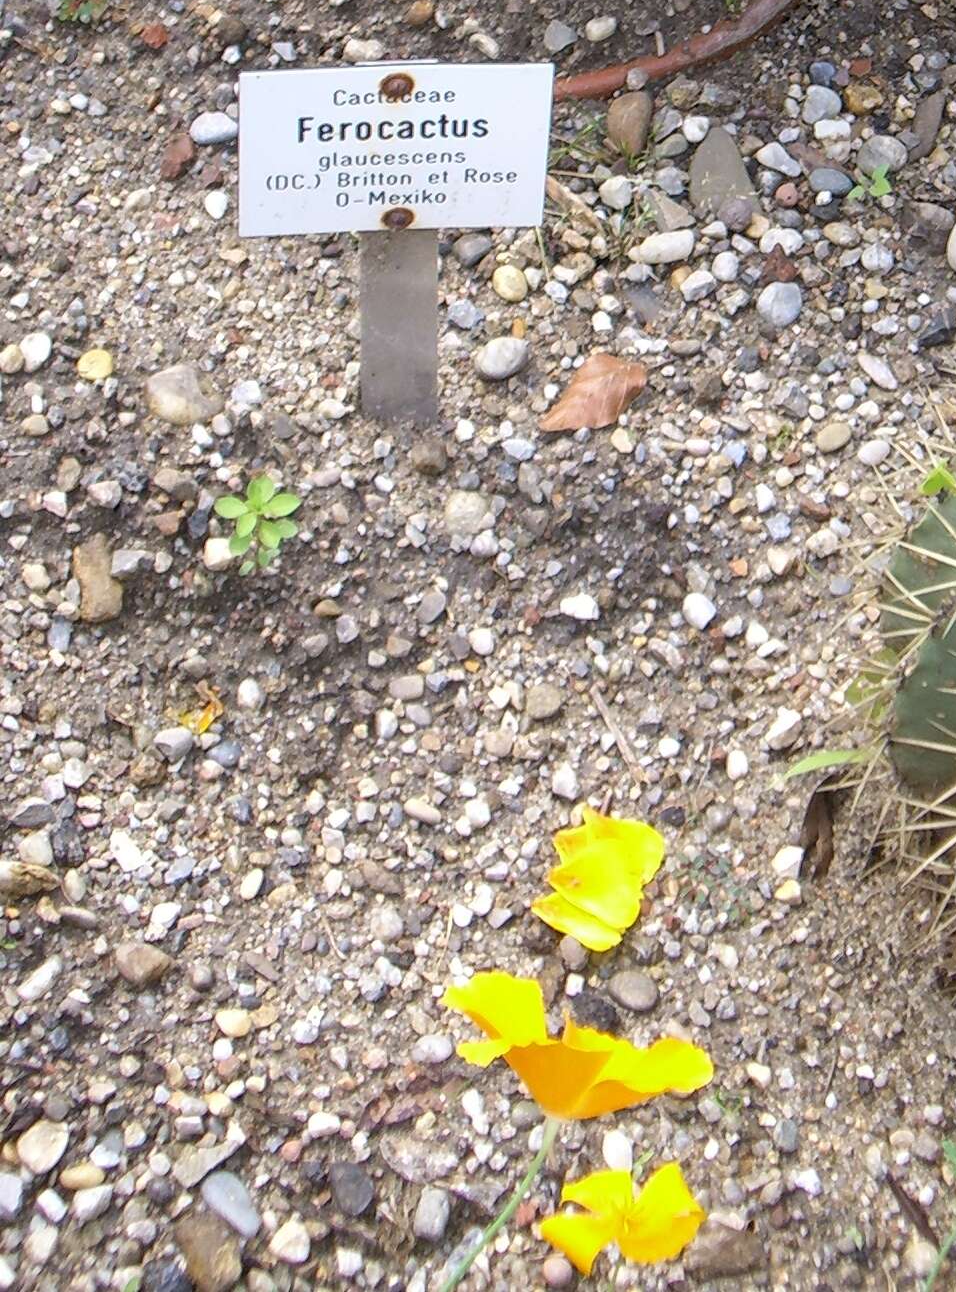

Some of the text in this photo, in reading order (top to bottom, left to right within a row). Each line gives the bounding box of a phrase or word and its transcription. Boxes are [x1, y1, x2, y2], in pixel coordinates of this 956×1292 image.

[298, 114, 490, 143] Ferocactus
[318, 150, 467, 172] glaucescens
[266, 169, 518, 190] (DC.) Britton et Rose
